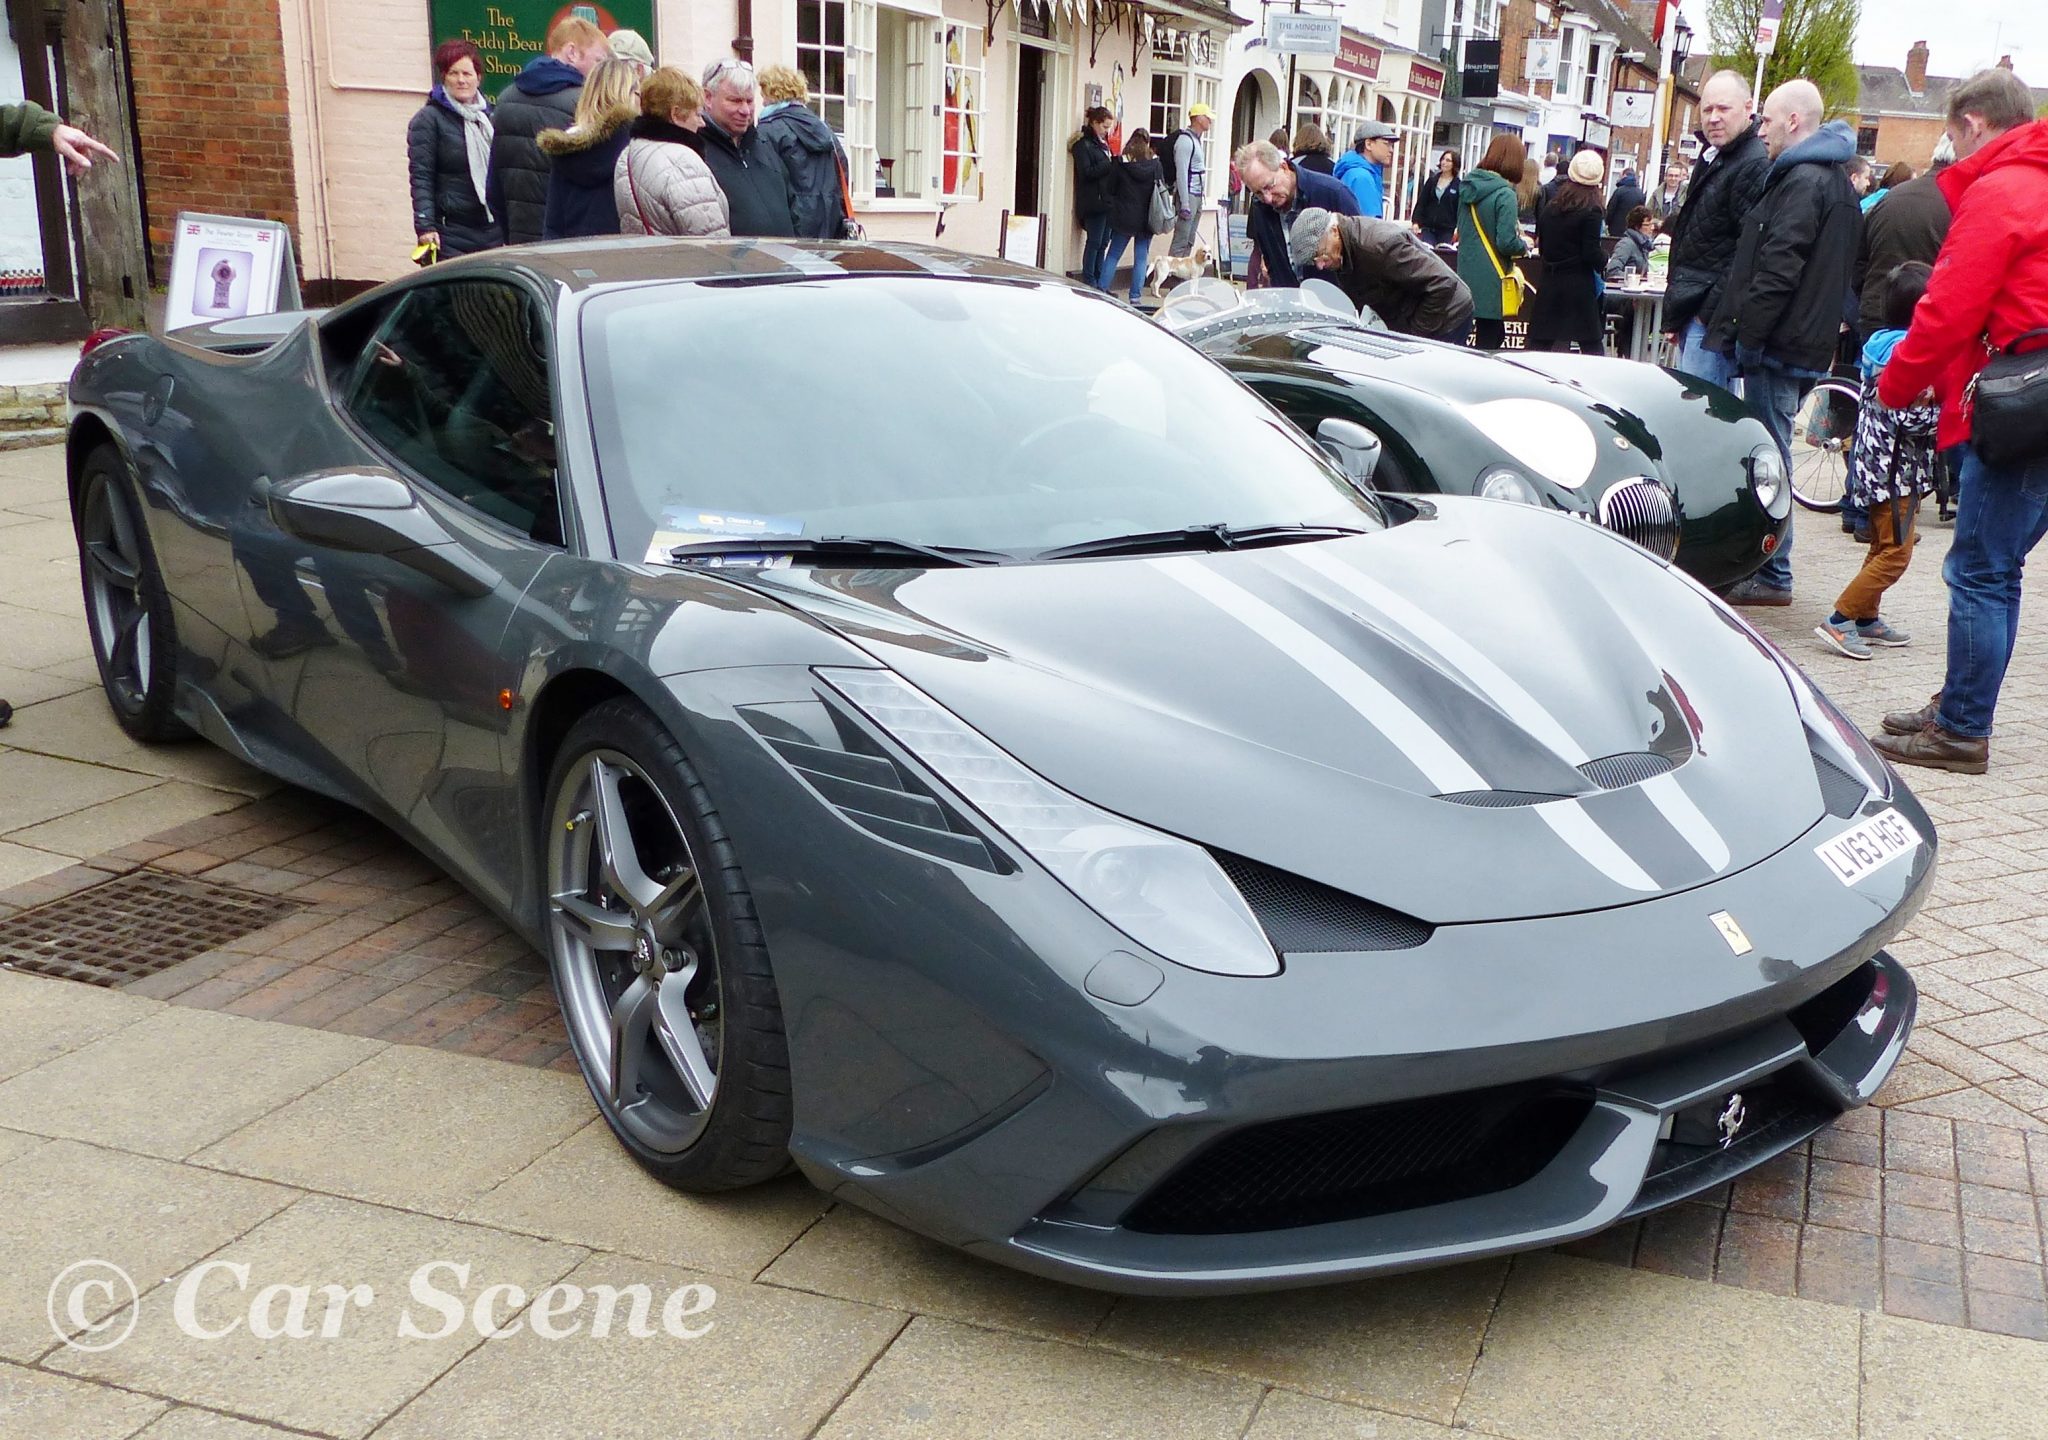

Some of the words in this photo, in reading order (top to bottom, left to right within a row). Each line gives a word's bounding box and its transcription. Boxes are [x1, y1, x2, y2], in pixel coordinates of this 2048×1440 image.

[486, 7, 514, 27] The
[1279, 22, 1292, 30] THE
[1294, 22, 1332, 32] MINORIES
[462, 29, 505, 53] Teddy
[508, 31, 544, 52] Bear
[485, 56, 523, 77] Shop
[1824, 831, 1884, 879] LV63
[1868, 814, 1911, 853] HGF
